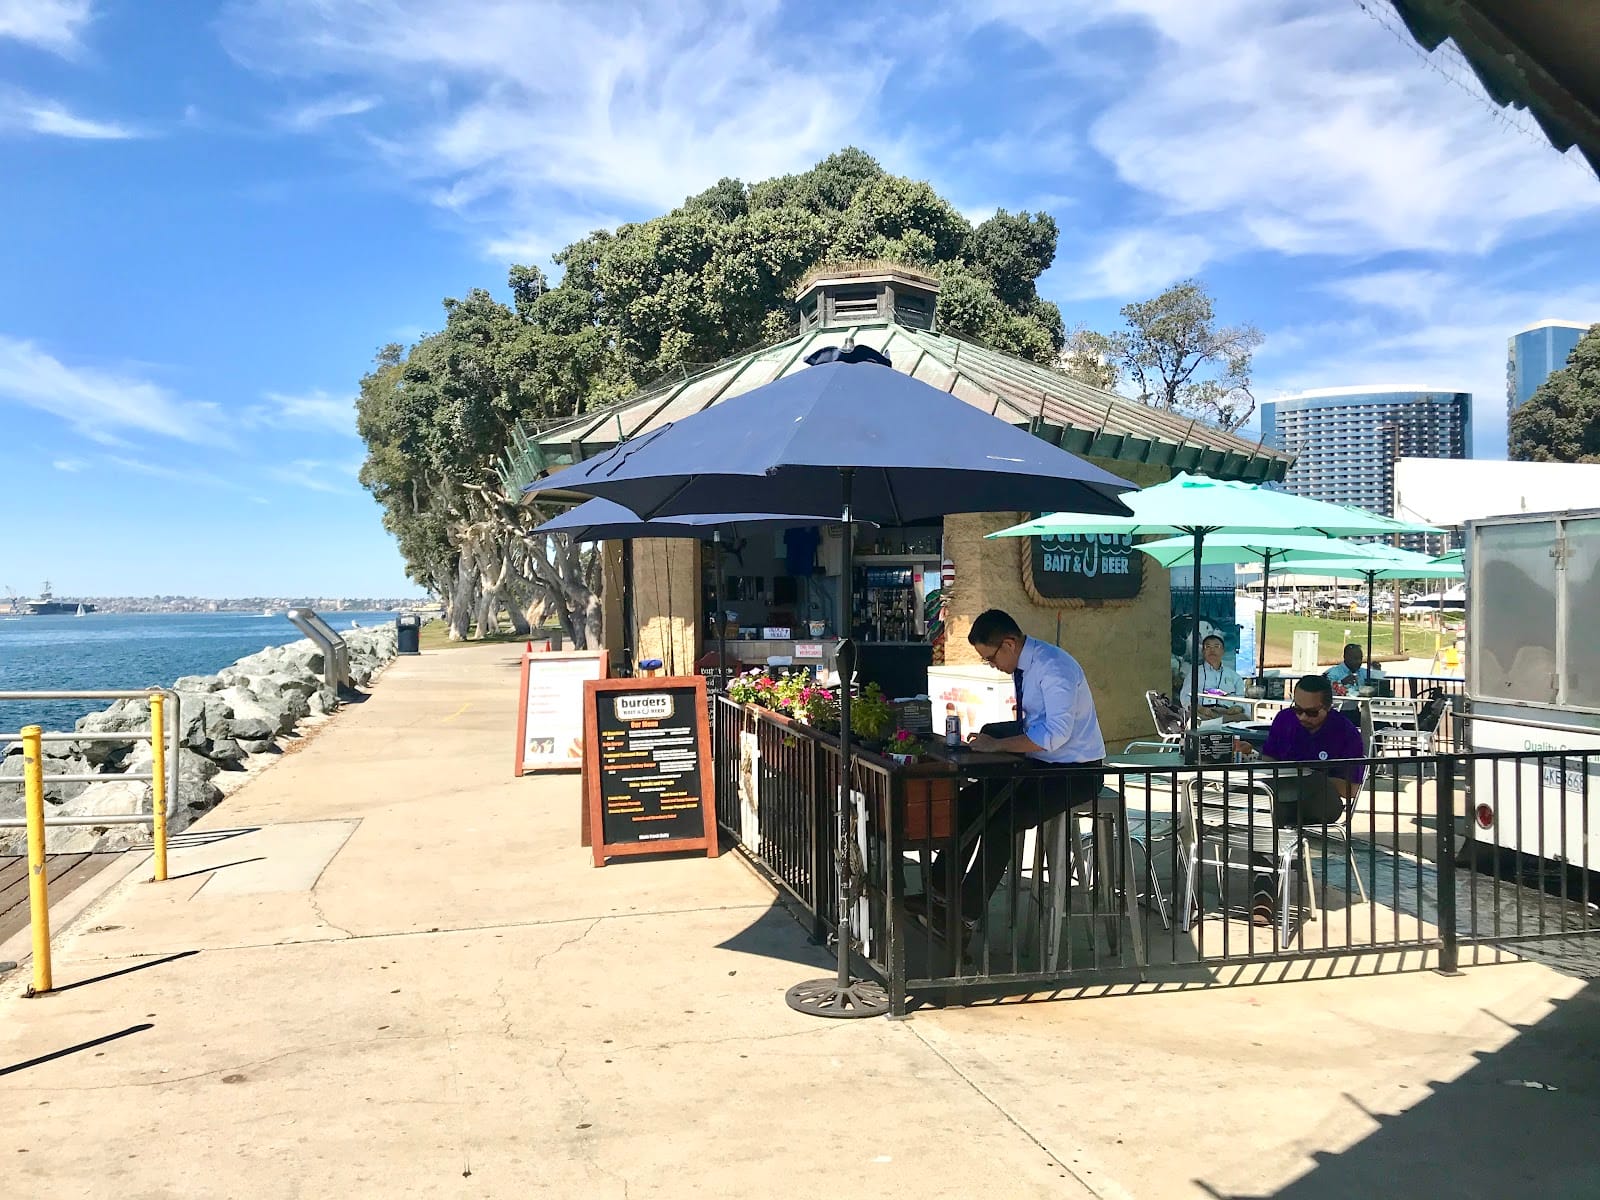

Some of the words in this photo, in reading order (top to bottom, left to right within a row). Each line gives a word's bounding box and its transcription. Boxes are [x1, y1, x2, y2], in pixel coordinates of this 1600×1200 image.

[1043, 553, 1071, 572] BAIT
[1072, 555, 1082, 573] &
[1101, 556, 1129, 574] BEER
[1524, 739, 1557, 752] Quality
